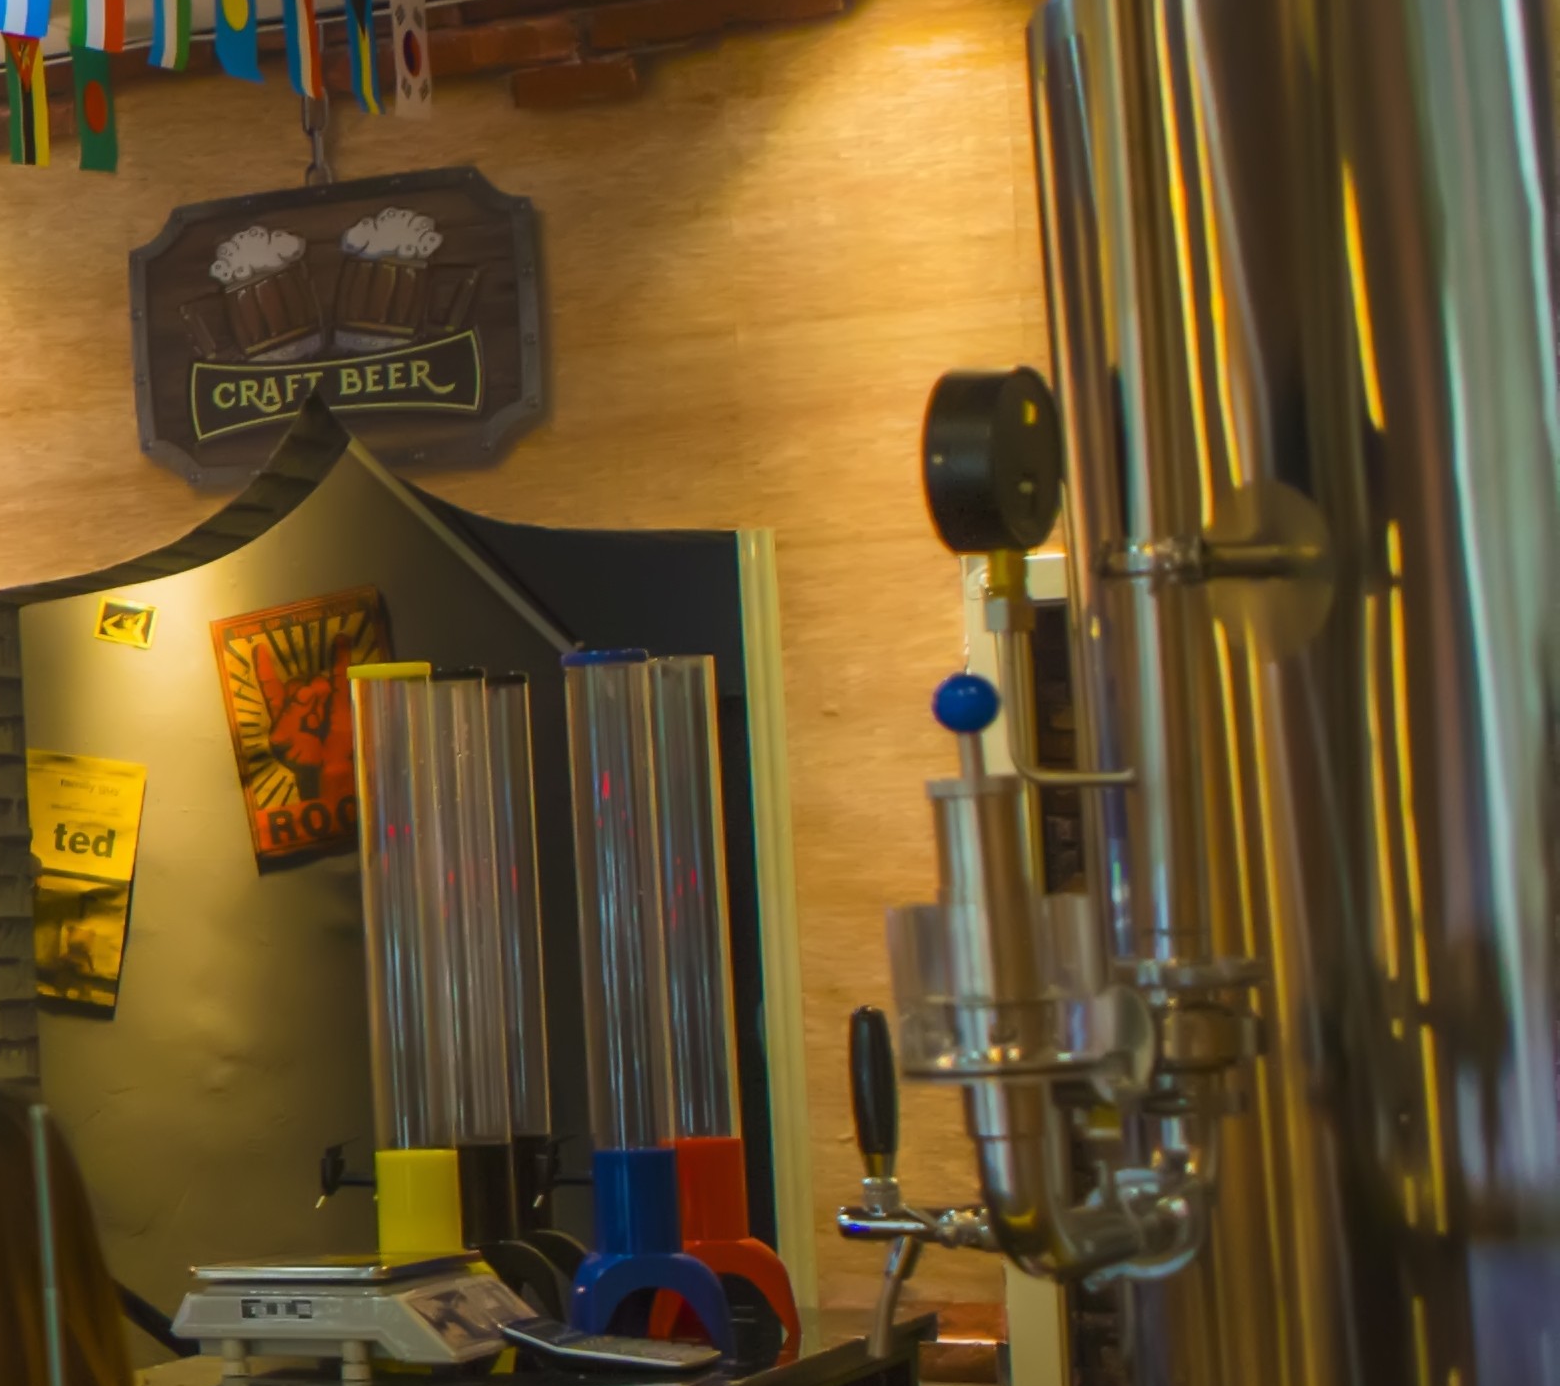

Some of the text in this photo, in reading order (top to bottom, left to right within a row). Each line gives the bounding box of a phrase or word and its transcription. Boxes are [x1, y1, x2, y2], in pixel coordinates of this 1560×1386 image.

[211, 359, 457, 413] CRAFT BEER
[53, 822, 117, 860] ted
